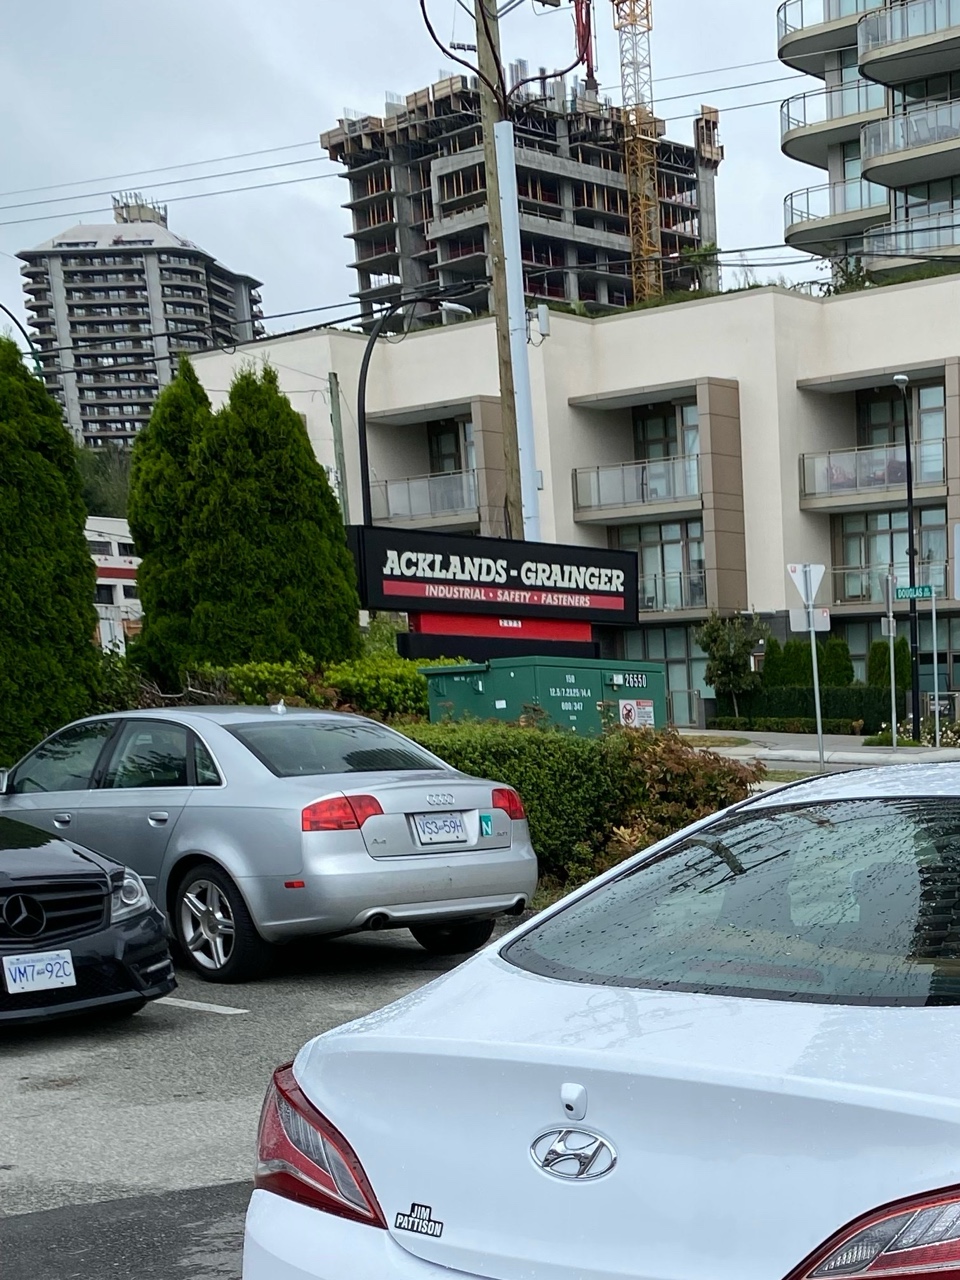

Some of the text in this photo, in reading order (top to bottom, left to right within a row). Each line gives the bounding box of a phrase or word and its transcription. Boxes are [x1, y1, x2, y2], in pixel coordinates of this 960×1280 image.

[425, 584, 590, 607] INDUSTRIAL SAFETY FASTENERS
[897, 587, 923, 598] DOUGLAS
[625, 673, 647, 688] 26550
[482, 821, 492, 836] N
[411, 1205, 430, 1220] JIM
[396, 1214, 442, 1236] PATTISON
